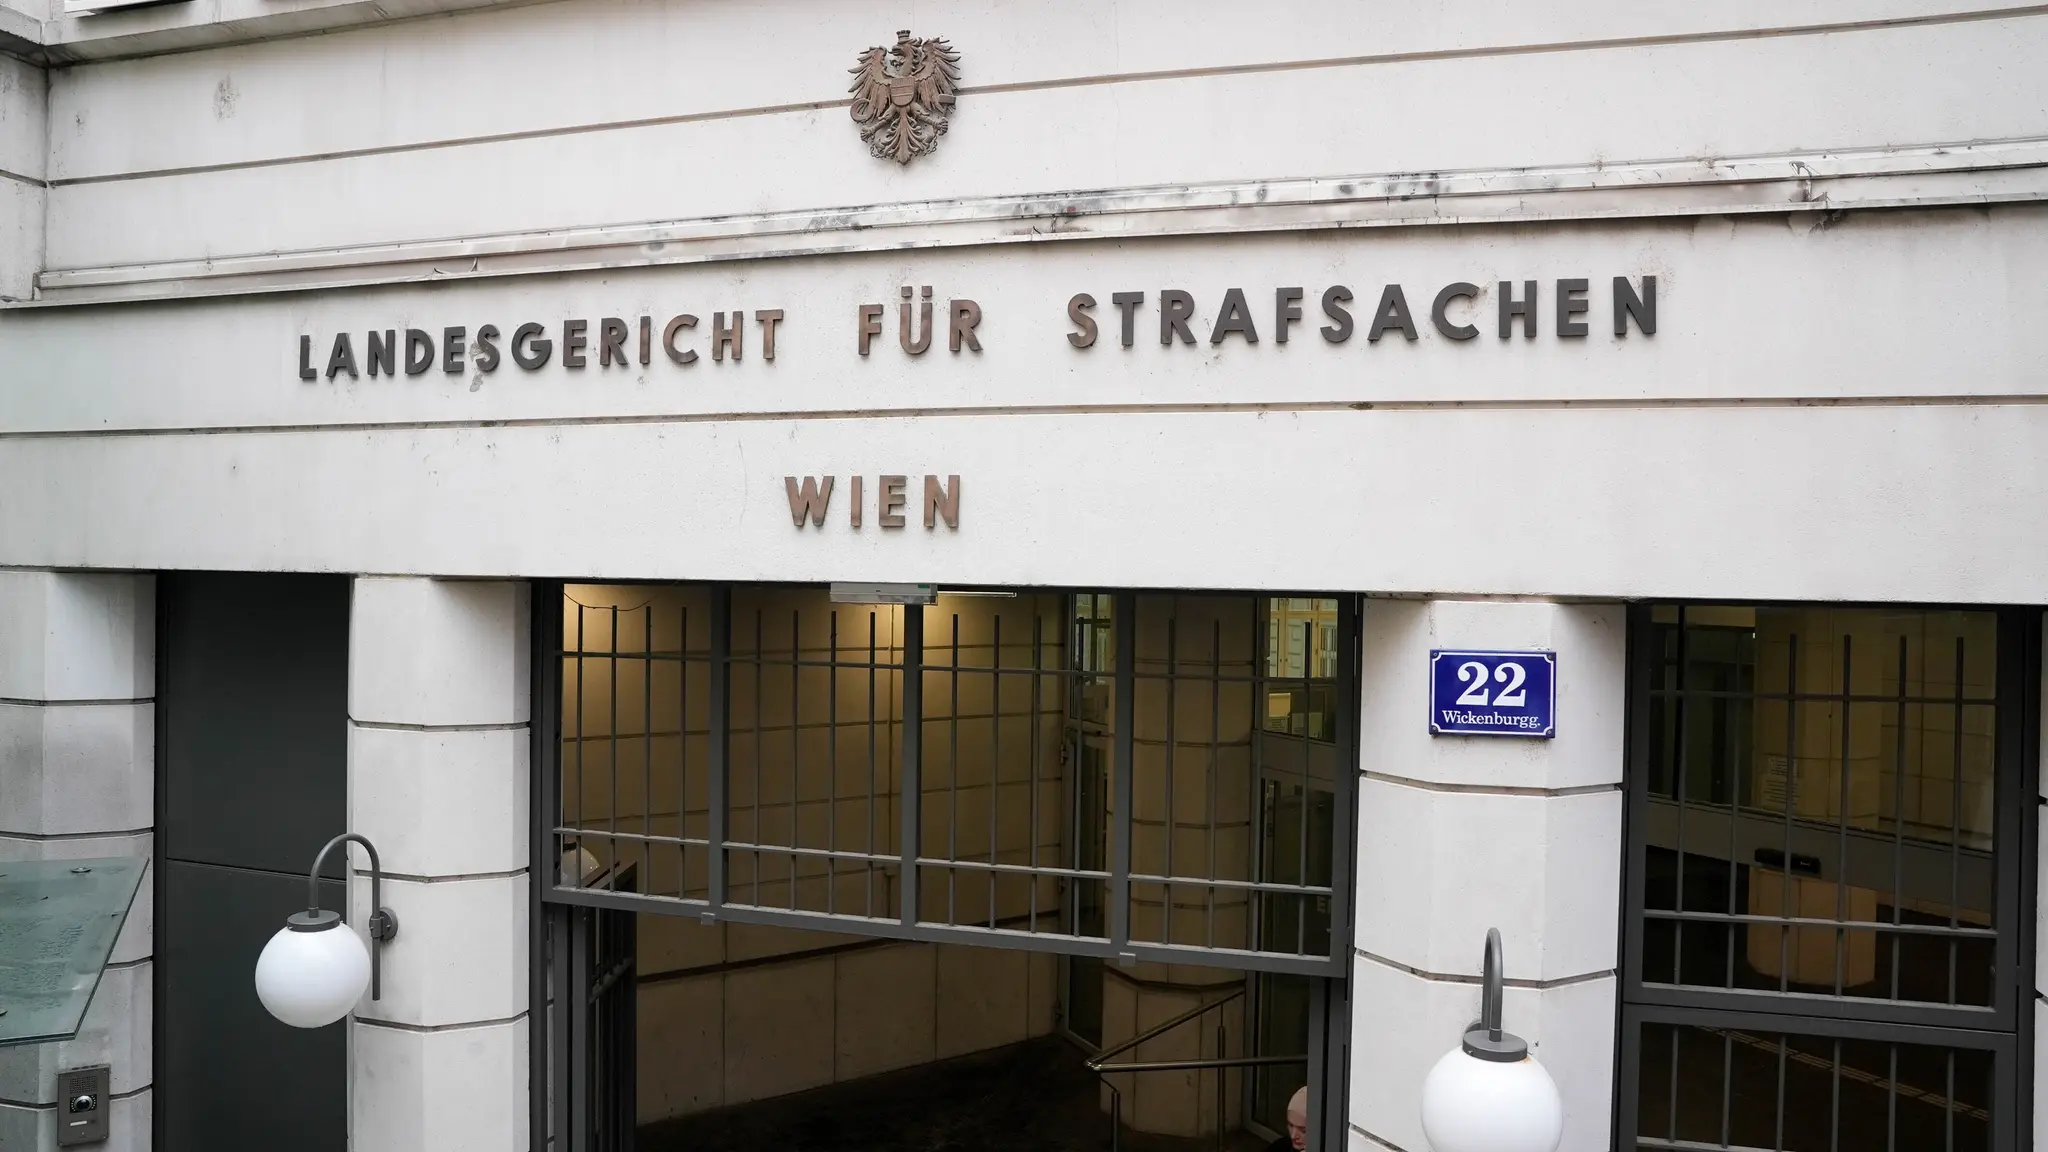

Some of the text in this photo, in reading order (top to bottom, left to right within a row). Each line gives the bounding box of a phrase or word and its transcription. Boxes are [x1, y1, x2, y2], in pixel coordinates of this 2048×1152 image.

[299, 276, 1657, 380] LANDESGERICHT FÜR STRAFSACHEN
[785, 474, 961, 528] WIEN
[1455, 661, 1527, 707] 22
[1442, 710, 1541, 729] Wickenburgg.
